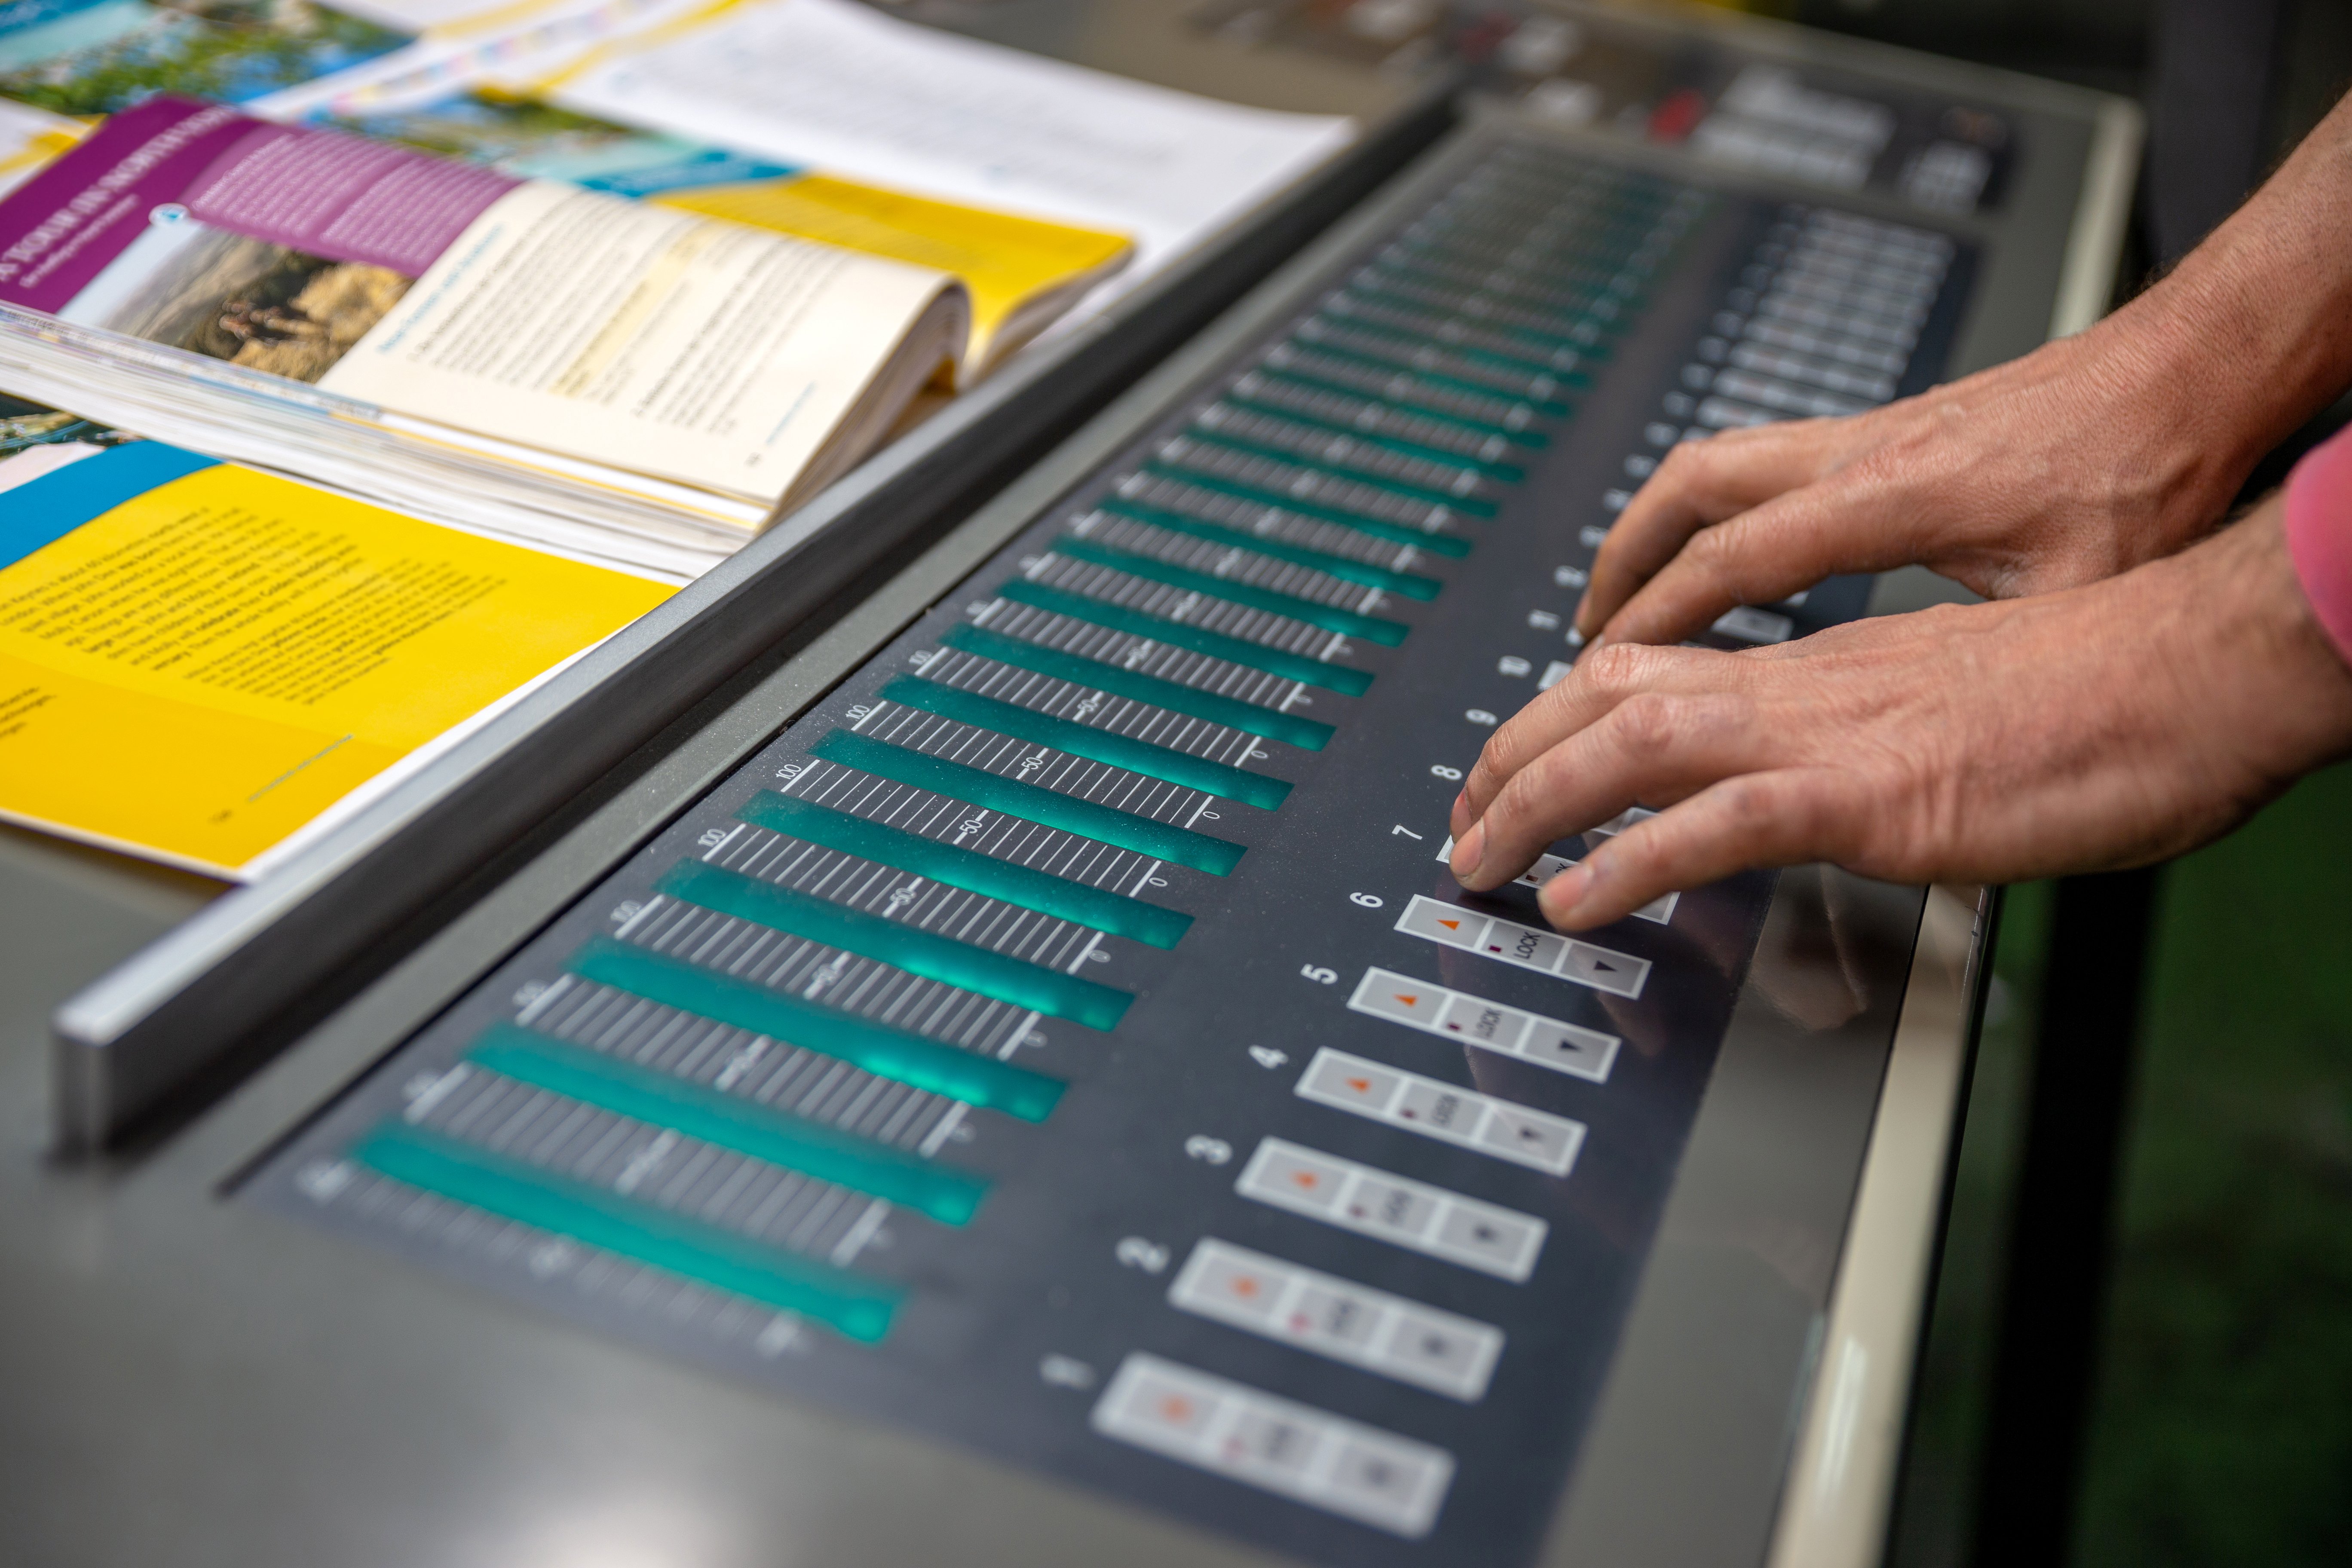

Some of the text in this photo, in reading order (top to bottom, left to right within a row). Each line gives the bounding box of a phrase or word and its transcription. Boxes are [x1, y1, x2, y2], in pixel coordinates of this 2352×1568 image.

[845, 704, 870, 720] 100
[1077, 699, 1099, 712] 50
[1465, 708, 1498, 726] 9
[1251, 750, 1268, 760] 0
[775, 764, 802, 779] 100
[1021, 757, 1044, 770] 50
[1430, 765, 1462, 781] 8
[959, 819, 983, 834] 50
[1391, 824, 1423, 840] 7
[697, 828, 726, 847] 100
[1148, 877, 1168, 887] 0
[1350, 892, 1384, 908] 6
[1514, 932, 1540, 960] LOCK
[1300, 963, 1338, 985] 5
[1475, 1007, 1502, 1038] LOCK
[1247, 1044, 1289, 1069] 4
